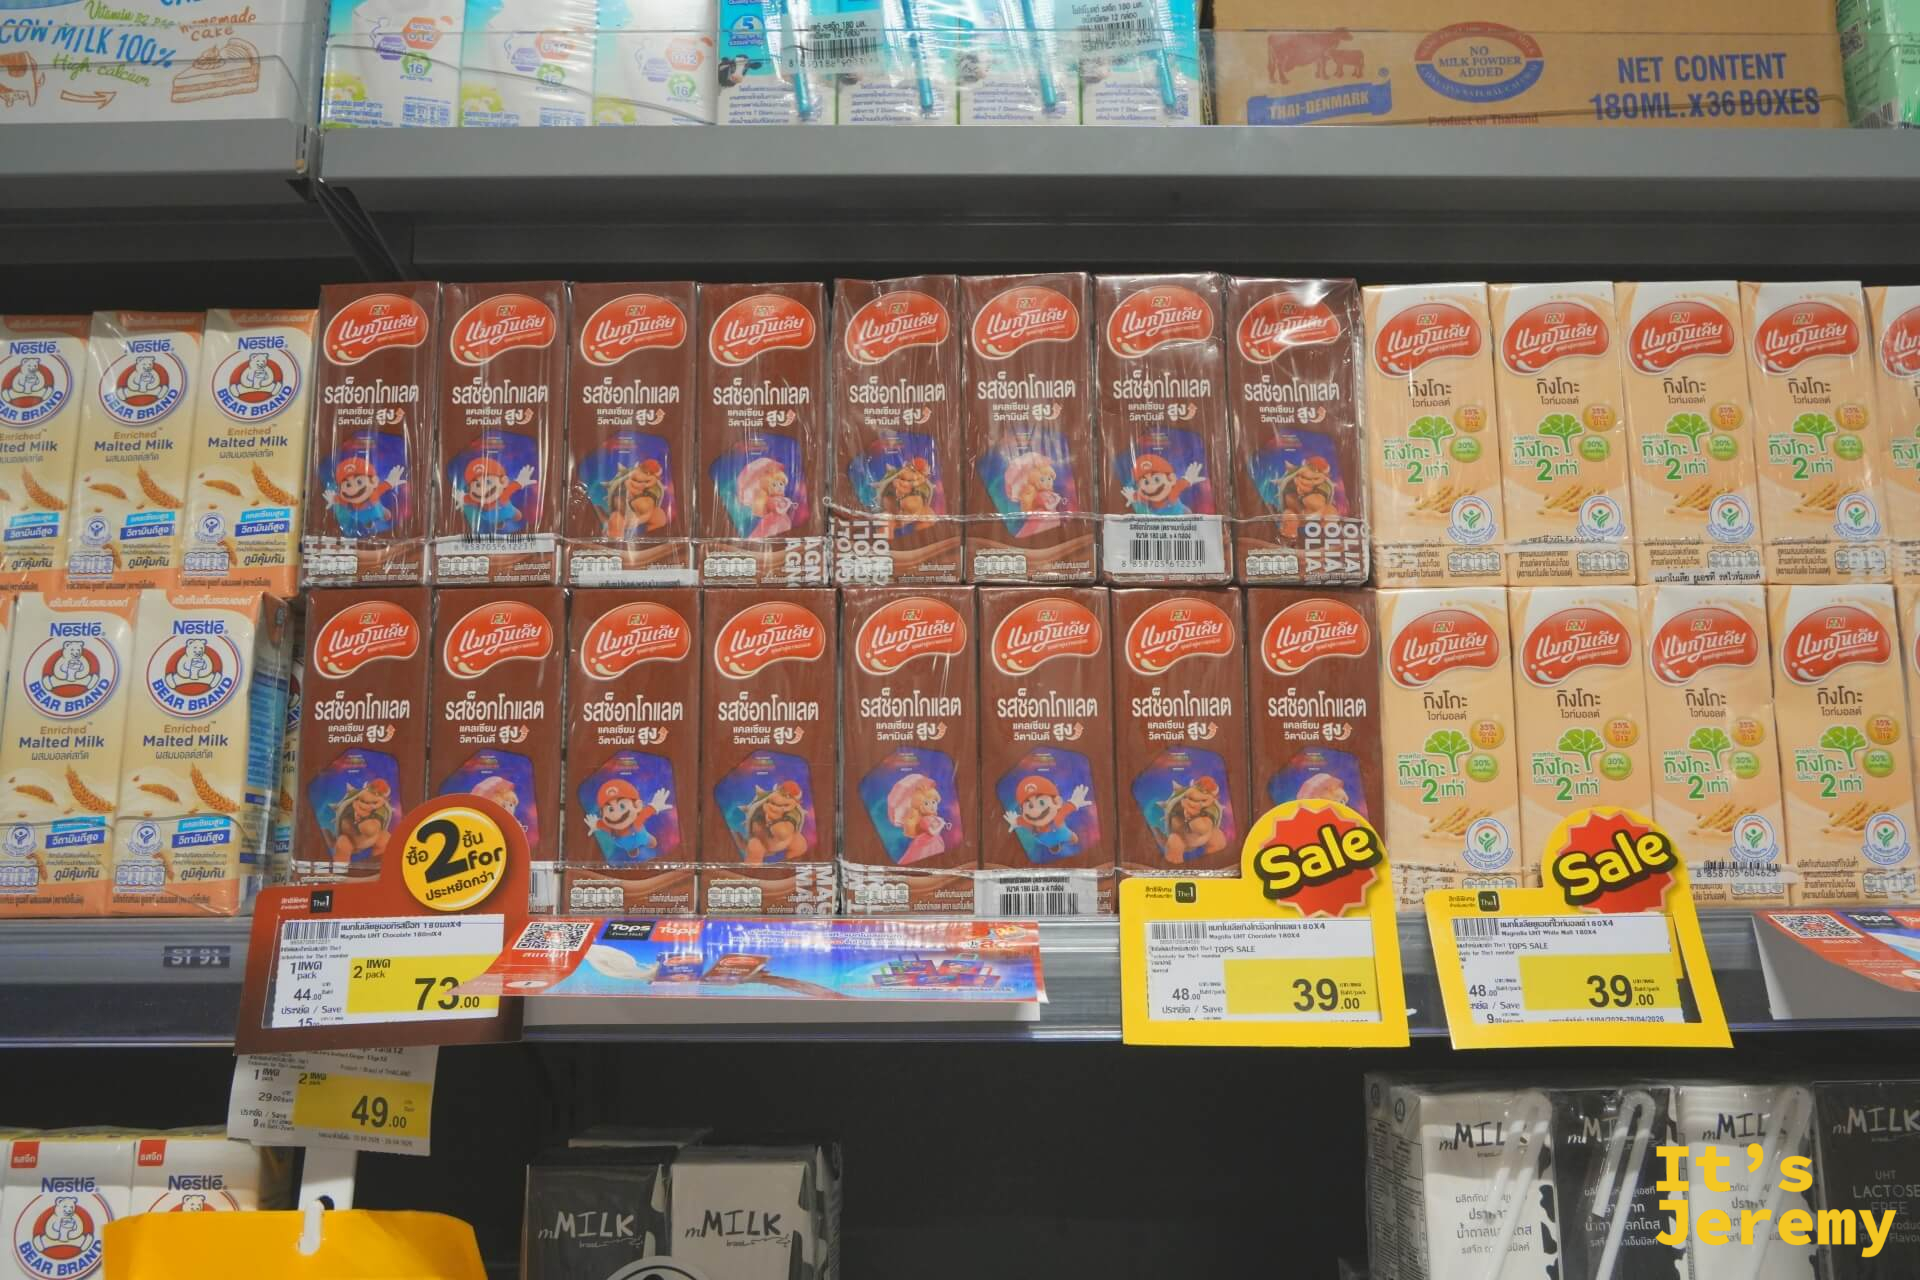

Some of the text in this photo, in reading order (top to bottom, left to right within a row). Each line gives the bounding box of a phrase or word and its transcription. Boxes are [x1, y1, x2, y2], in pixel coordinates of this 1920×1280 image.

[191, 26, 233, 41] cake
[0, 18, 176, 68] COW MILK 100%
[1470, 46, 1489, 57] NO
[53, 52, 90, 79] High
[1439, 56, 1522, 68] MILK POWDER
[1618, 53, 1787, 84] NET CONTENT
[1459, 67, 1504, 78] ADDED
[238, 336, 285, 351] Nestlé
[324, 377, 419, 404] รสช็อกโกแลต
[452, 377, 548, 404] รสช็อกโกแลต
[850, 376, 946, 404] รสช็อกโกแลต
[1113, 370, 1211, 399] รสช็อกโกแลต
[1537, 378, 1580, 394] กิงโกะ
[1788, 377, 1831, 394] กิงโกะ
[21, 391, 64, 421] BRAND
[136, 388, 178, 420] BRAND
[217, 385, 292, 416] BEAR BRAND
[114, 430, 157, 440] Enriched
[227, 427, 271, 436] Enriched
[30, 441, 57, 452] Milk
[94, 439, 173, 452] Malted Milk
[208, 436, 288, 448] Malted Milk
[1536, 460, 1552, 480] 2
[50, 622, 102, 637] Nestlé
[173, 620, 224, 635] Nestlé
[29, 678, 110, 712] BEAR BRAND
[152, 676, 233, 711] BEAR BRAND
[1424, 690, 1468, 709] กิงโกะ
[1557, 689, 1601, 707] กิงโกะ
[1685, 689, 1727, 706] กิงโกะ
[445, 691, 544, 720] รสช็อกโกแลต
[583, 692, 683, 721] รสช็อกโกแลต
[860, 688, 961, 717] รสช็อกโกแลต
[997, 688, 1098, 717] รสช็อกโกแลต
[40, 725, 87, 735] Enriched
[163, 724, 210, 733] Enriched
[19, 735, 105, 748] Malted Milk
[143, 734, 228, 747] Malted Milk
[1422, 779, 1438, 802] 2
[1820, 774, 1837, 797] 2
[406, 819, 483, 884] ซื้อ 2 ชิ้น
[467, 846, 503, 871] for
[1259, 826, 1376, 890] Sale
[1558, 831, 1670, 896] Sale
[425, 869, 495, 901] ประหยัดกว่า
[1849, 914, 1893, 922] Tops
[610, 923, 651, 932] Tops
[297, 970, 385, 980] pack pack
[353, 966, 362, 979] 2
[1172, 988, 1201, 1001] 48.00
[1291, 977, 1360, 1012] 39.00
[1469, 984, 1498, 997] 48.00
[1587, 975, 1654, 1008] 39.00
[322, 1005, 341, 1014] Save
[1202, 1004, 1223, 1014] Save
[1500, 1001, 1520, 1010] Save
[352, 1095, 407, 1129] 49.00
[168, 1175, 223, 1191] Nestlé
[1875, 1169, 1896, 1180] UHT
[42, 1177, 96, 1192] Nestlé
[19, 1241, 52, 1275] BEAR
